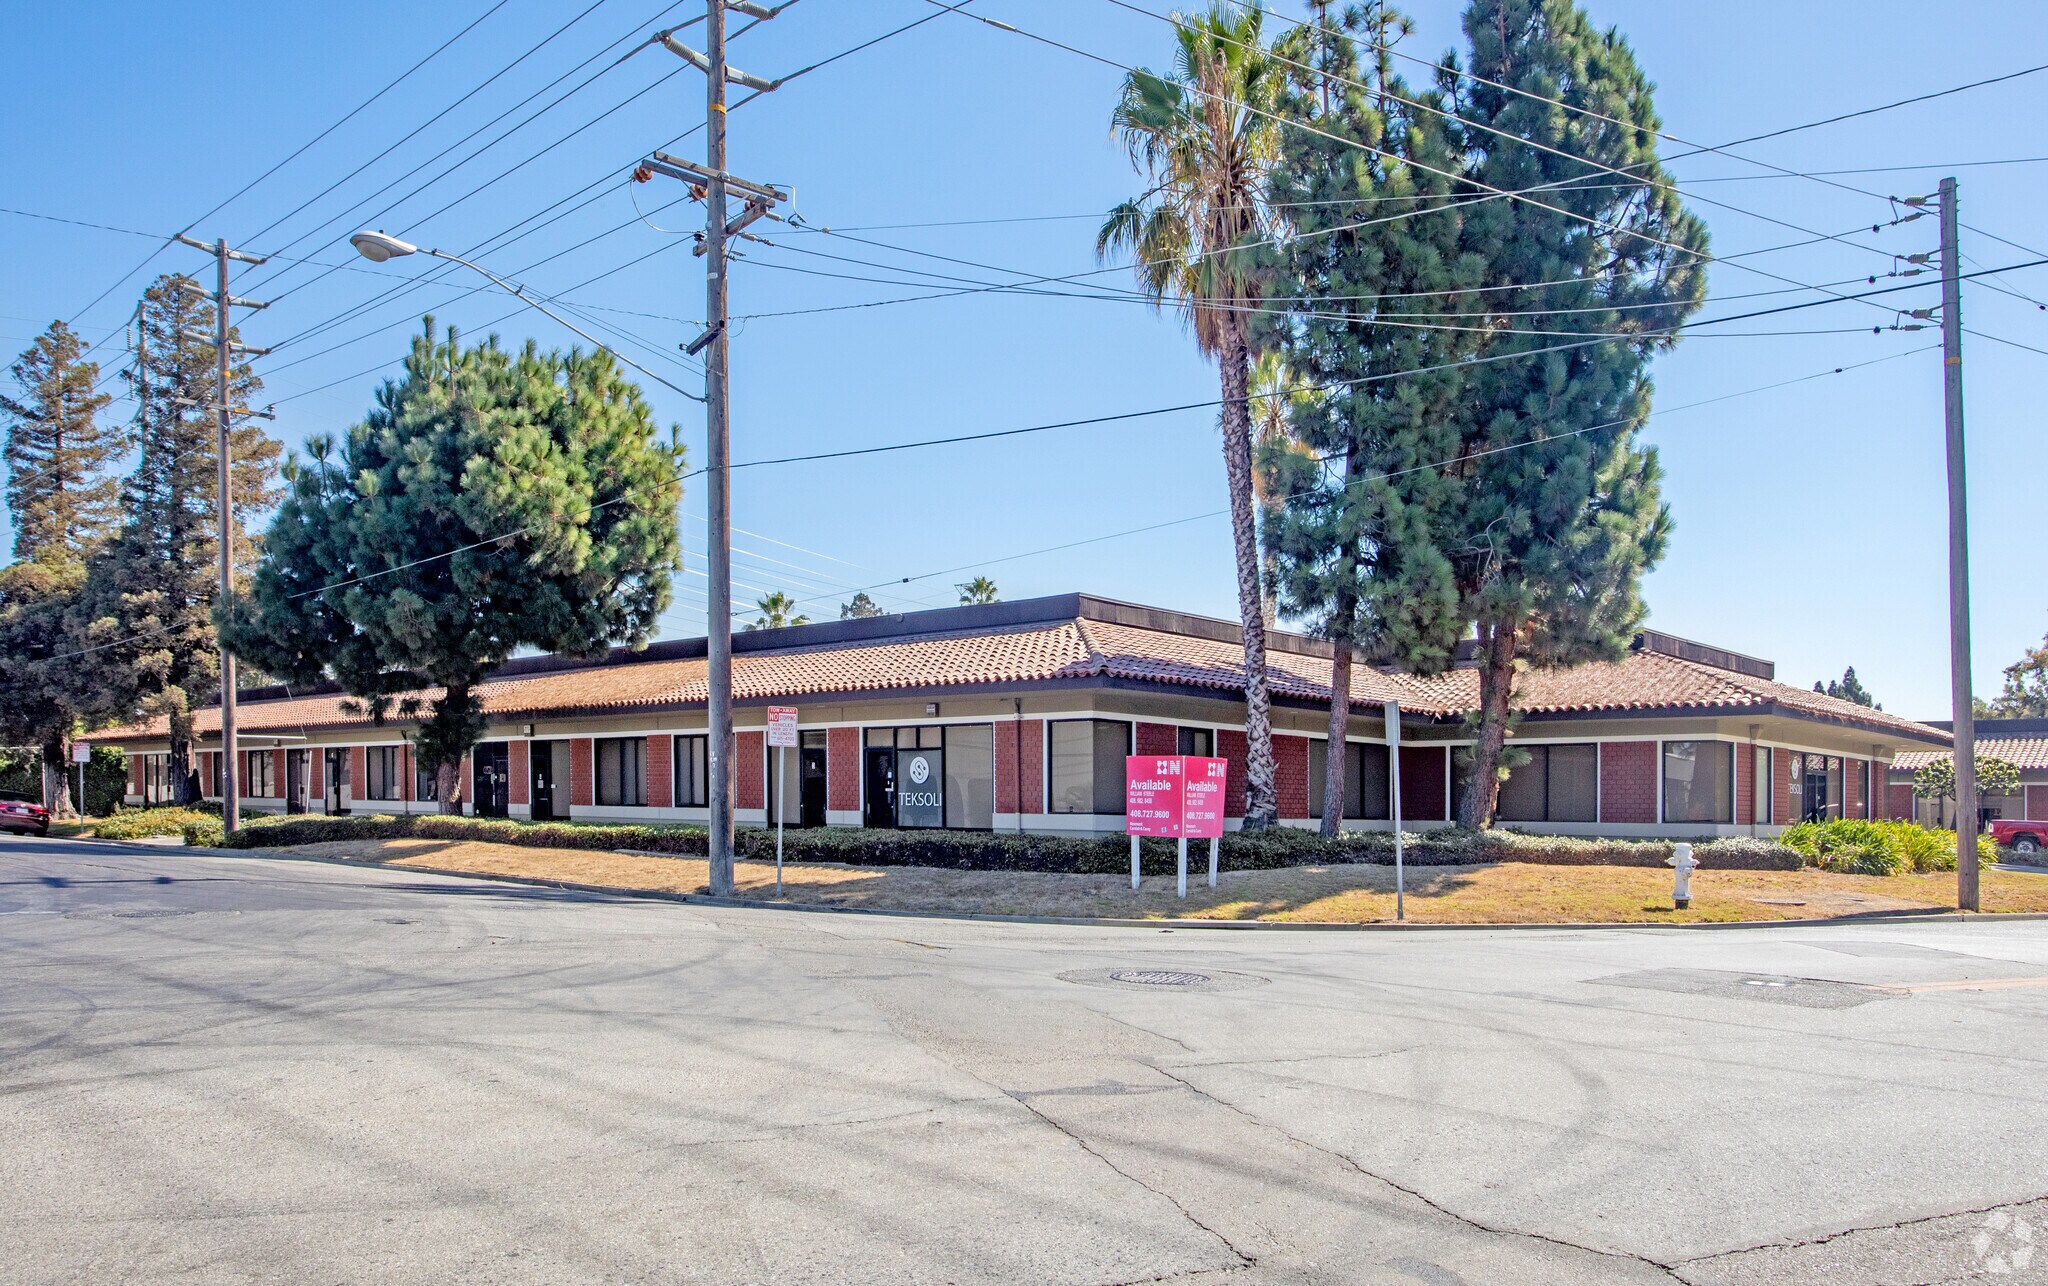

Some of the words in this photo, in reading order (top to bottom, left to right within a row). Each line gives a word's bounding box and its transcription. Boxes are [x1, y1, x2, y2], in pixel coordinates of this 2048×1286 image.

[769, 713, 778, 721] NO
[1130, 779, 1171, 791] Available
[1186, 780, 1218, 792] Available
[1130, 810, 1170, 818] 408.727.9600
